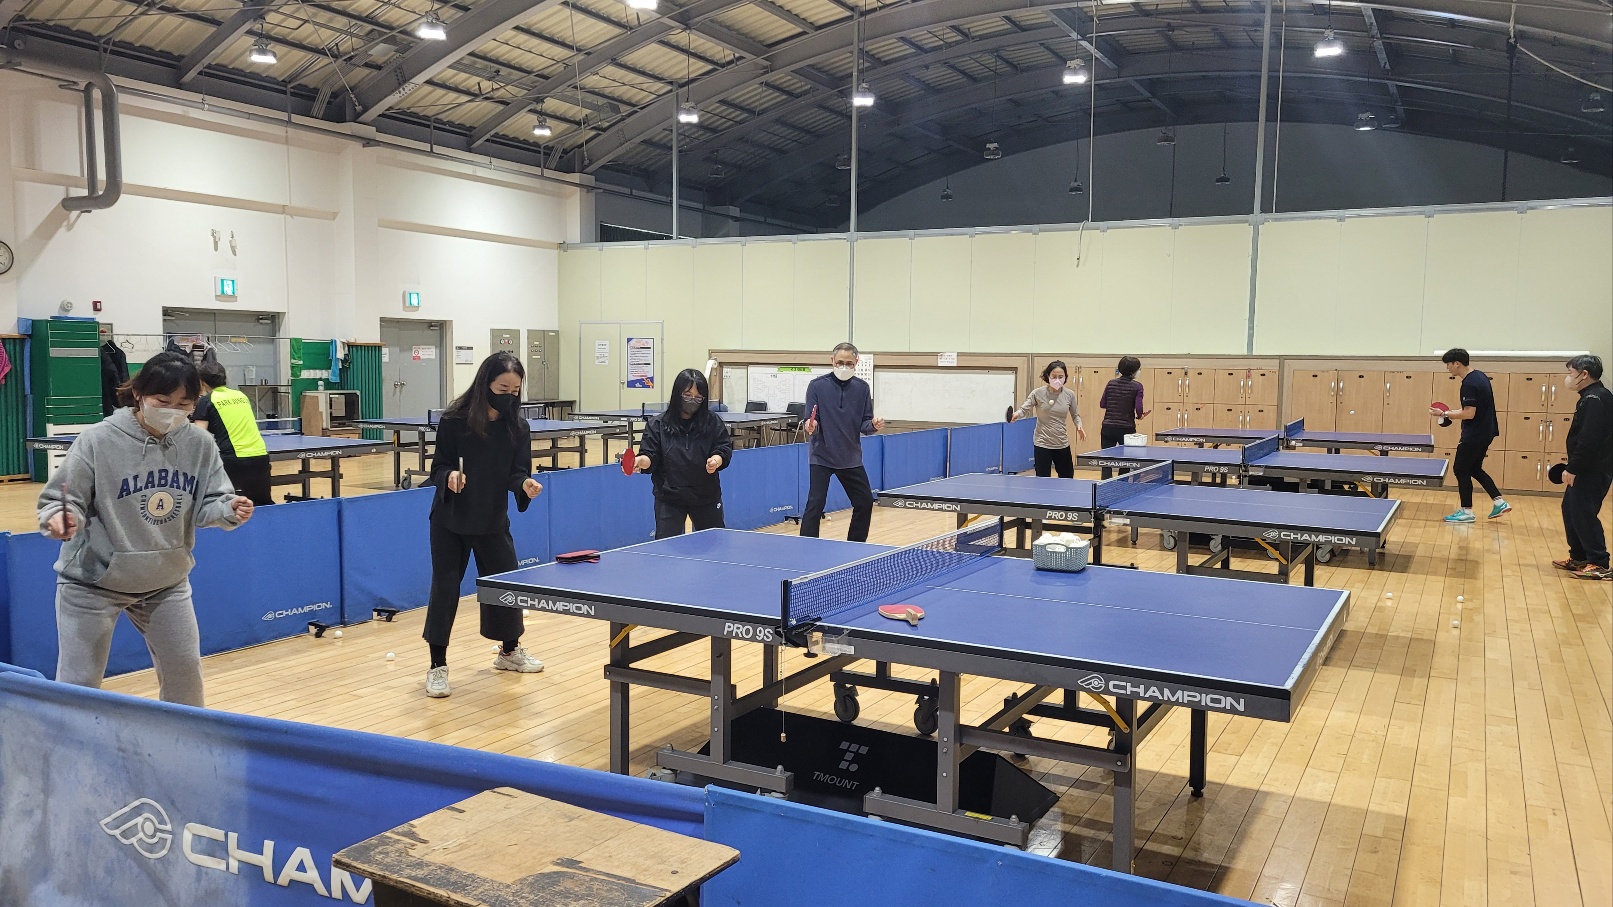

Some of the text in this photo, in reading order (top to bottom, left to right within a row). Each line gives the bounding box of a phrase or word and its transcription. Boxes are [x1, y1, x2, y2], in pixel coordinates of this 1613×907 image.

[1098, 460, 1141, 468] CHAMPION
[1204, 465, 1219, 473] PRO
[1373, 477, 1427, 486] CHAMPION
[905, 501, 961, 512] CHAMPION
[1046, 510, 1079, 521] PRO 9S
[1280, 531, 1356, 545] CHAMPION
[517, 596, 595, 616] CHAMPION
[723, 622, 774, 642] PRO 9S
[1108, 680, 1245, 712] CHAMPION
[812, 771, 860, 790] TMOUNT
